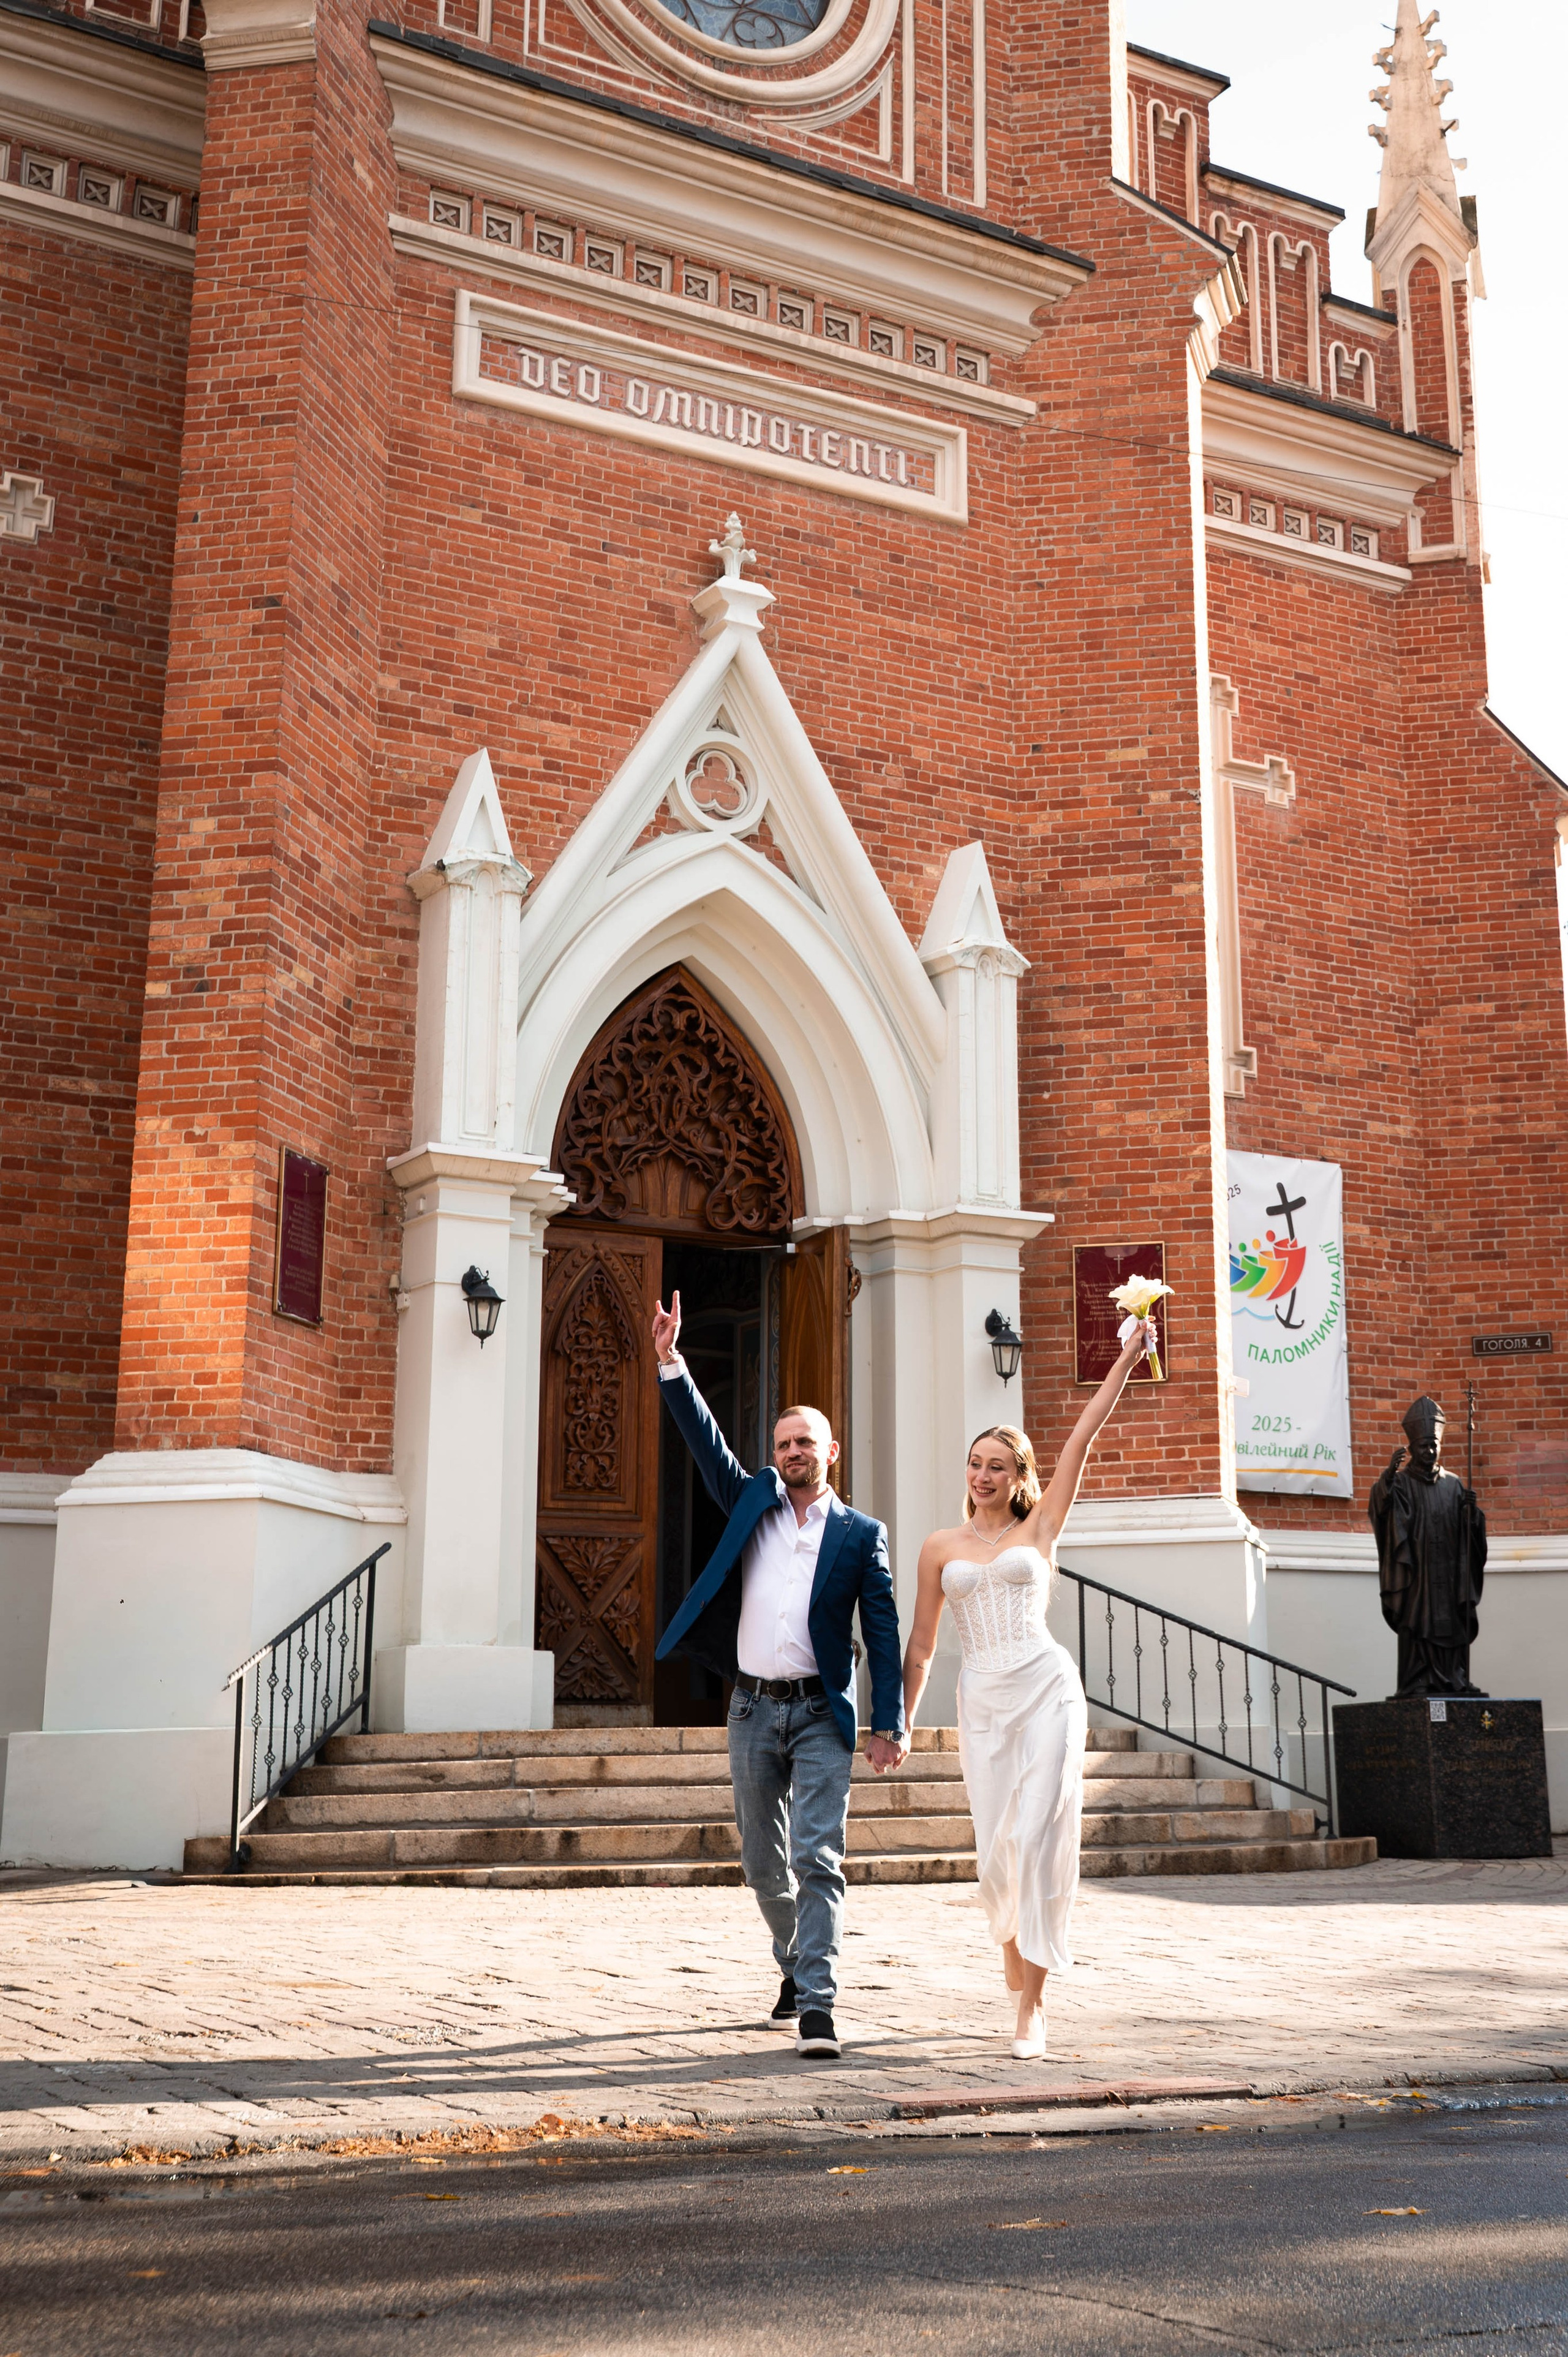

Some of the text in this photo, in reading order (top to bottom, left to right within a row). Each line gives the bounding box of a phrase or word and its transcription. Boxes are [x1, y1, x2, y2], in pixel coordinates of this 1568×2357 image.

[518, 347, 908, 486] DEO OMNIPOTENTI
[1248, 1241, 1341, 1363] ПАЛОМНИКИ НАДІЇ
[1535, 1337, 1542, 1347] 4
[1251, 1415, 1292, 1433] 2025
[1235, 1441, 1336, 1460] вілейний Рік
